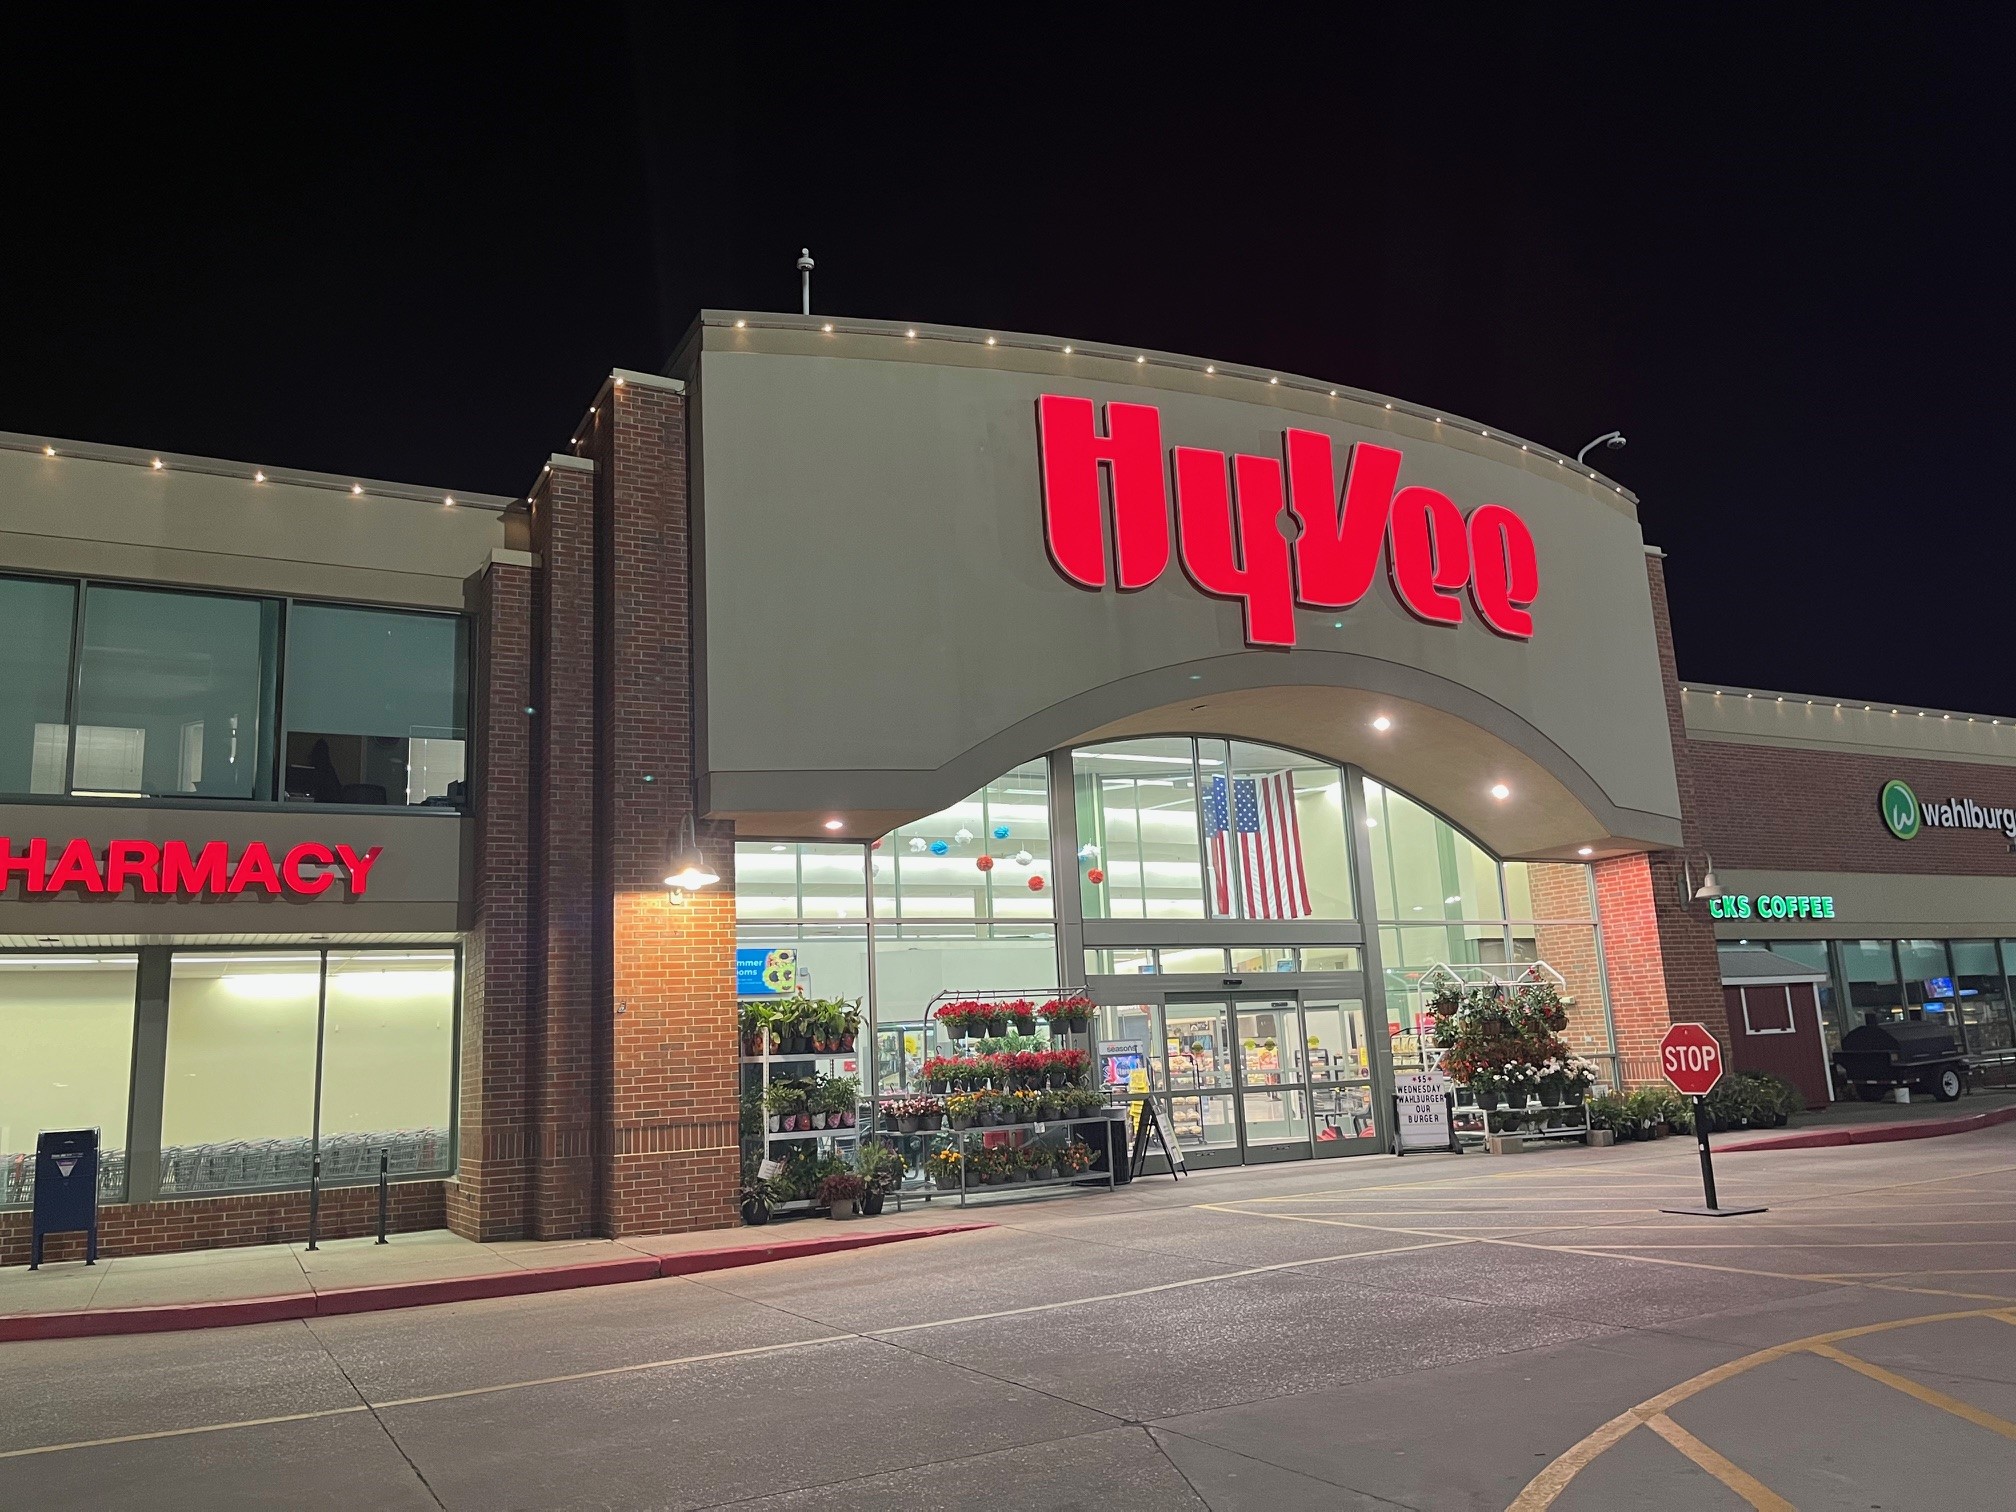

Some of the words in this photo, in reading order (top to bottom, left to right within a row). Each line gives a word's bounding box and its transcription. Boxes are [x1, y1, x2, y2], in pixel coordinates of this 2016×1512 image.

[1921, 797, 2016, 838] wahlburg
[1757, 895, 1835, 918] COFFEE
[1665, 1045, 1716, 1072] STOP
[1417, 1075, 1427, 1083] $5
[1397, 1085, 1441, 1094] WEDNESDAY
[1398, 1094, 1445, 1103] WAHLBURGER
[1415, 1105, 1431, 1113] OUR
[1408, 1114, 1439, 1123] BURGER
